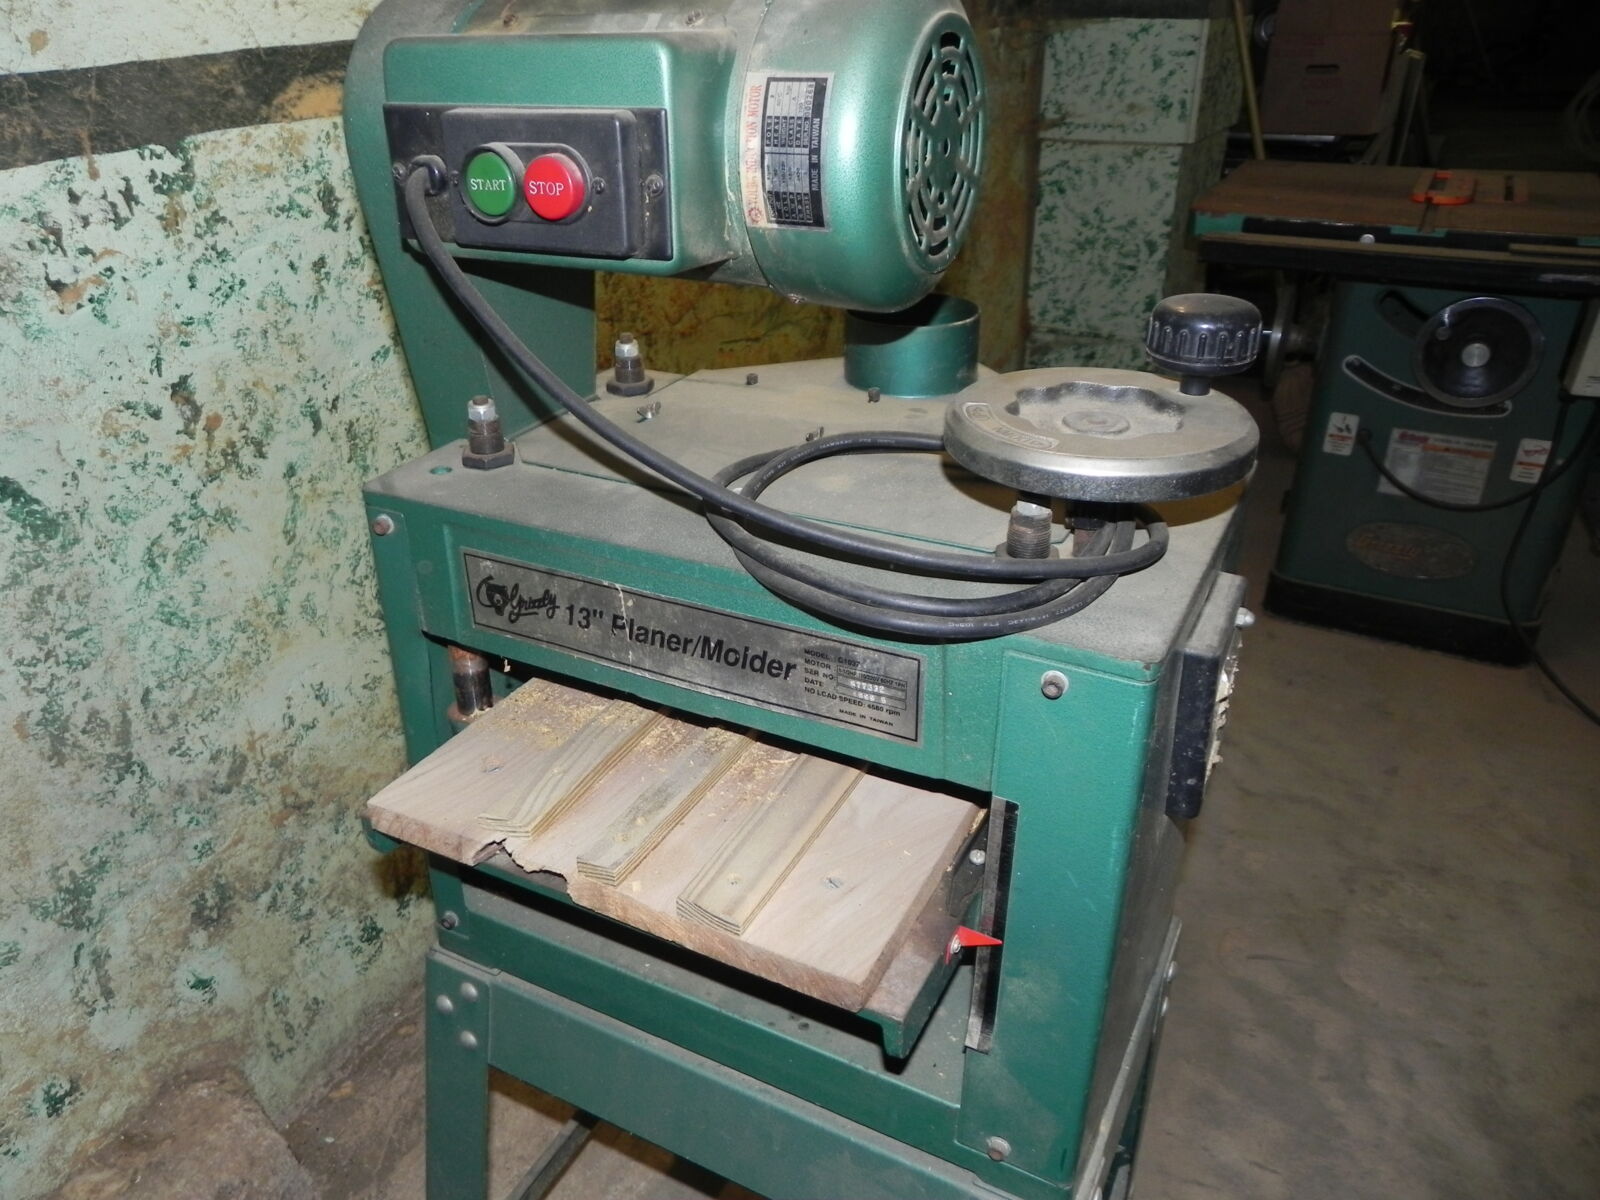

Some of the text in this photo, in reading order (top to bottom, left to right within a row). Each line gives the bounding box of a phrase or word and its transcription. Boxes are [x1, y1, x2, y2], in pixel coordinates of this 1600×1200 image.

[747, 84, 762, 118] MOTOR
[811, 118, 820, 148] TAIWAN
[811, 155, 818, 163] IN
[470, 178, 507, 192] START
[528, 180, 565, 196] STOP
[565, 604, 604, 630] 13"
[804, 687, 815, 695] NO
[885, 709, 900, 717] rpm
[839, 709, 856, 717] MADE
[869, 716, 894, 727] TAIWAN
